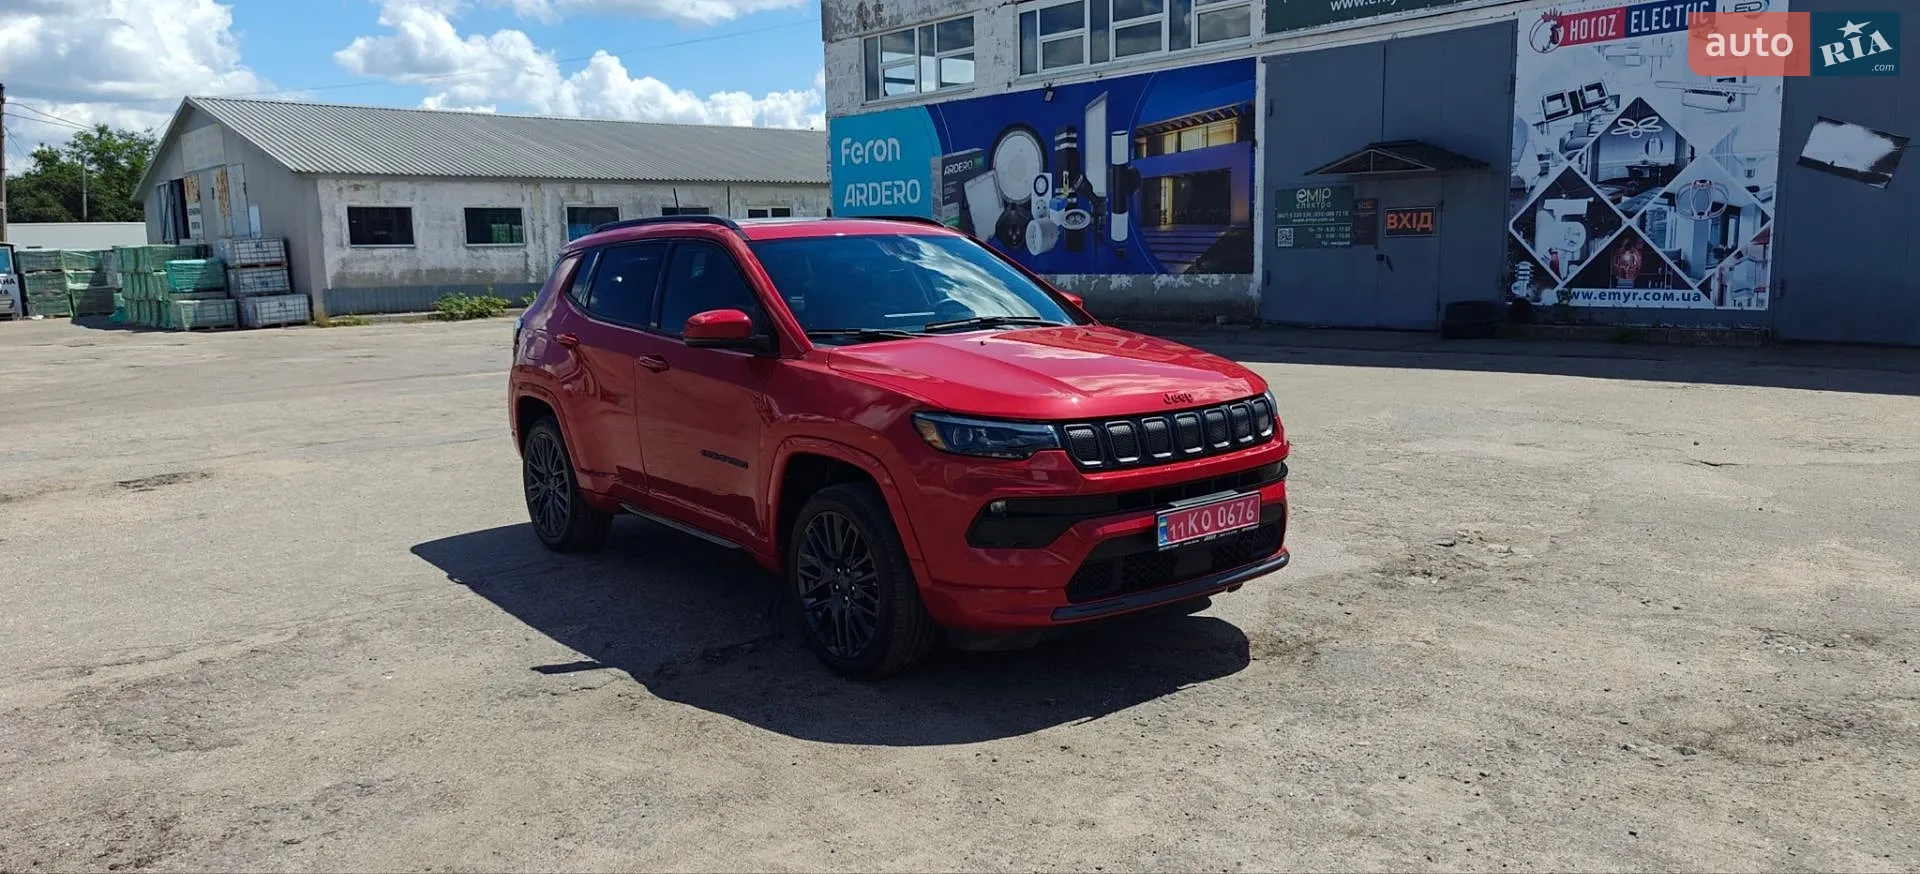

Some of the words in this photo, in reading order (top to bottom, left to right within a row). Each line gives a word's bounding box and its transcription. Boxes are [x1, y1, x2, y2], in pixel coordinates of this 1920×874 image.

[841, 137, 901, 166] Feron
[943, 160, 973, 176] ARDERO
[843, 179, 921, 207] ARDERO
[1387, 212, 1433, 232] ВХІД
[1163, 392, 1194, 405] Jeep
[1218, 500, 1254, 527] 0676
